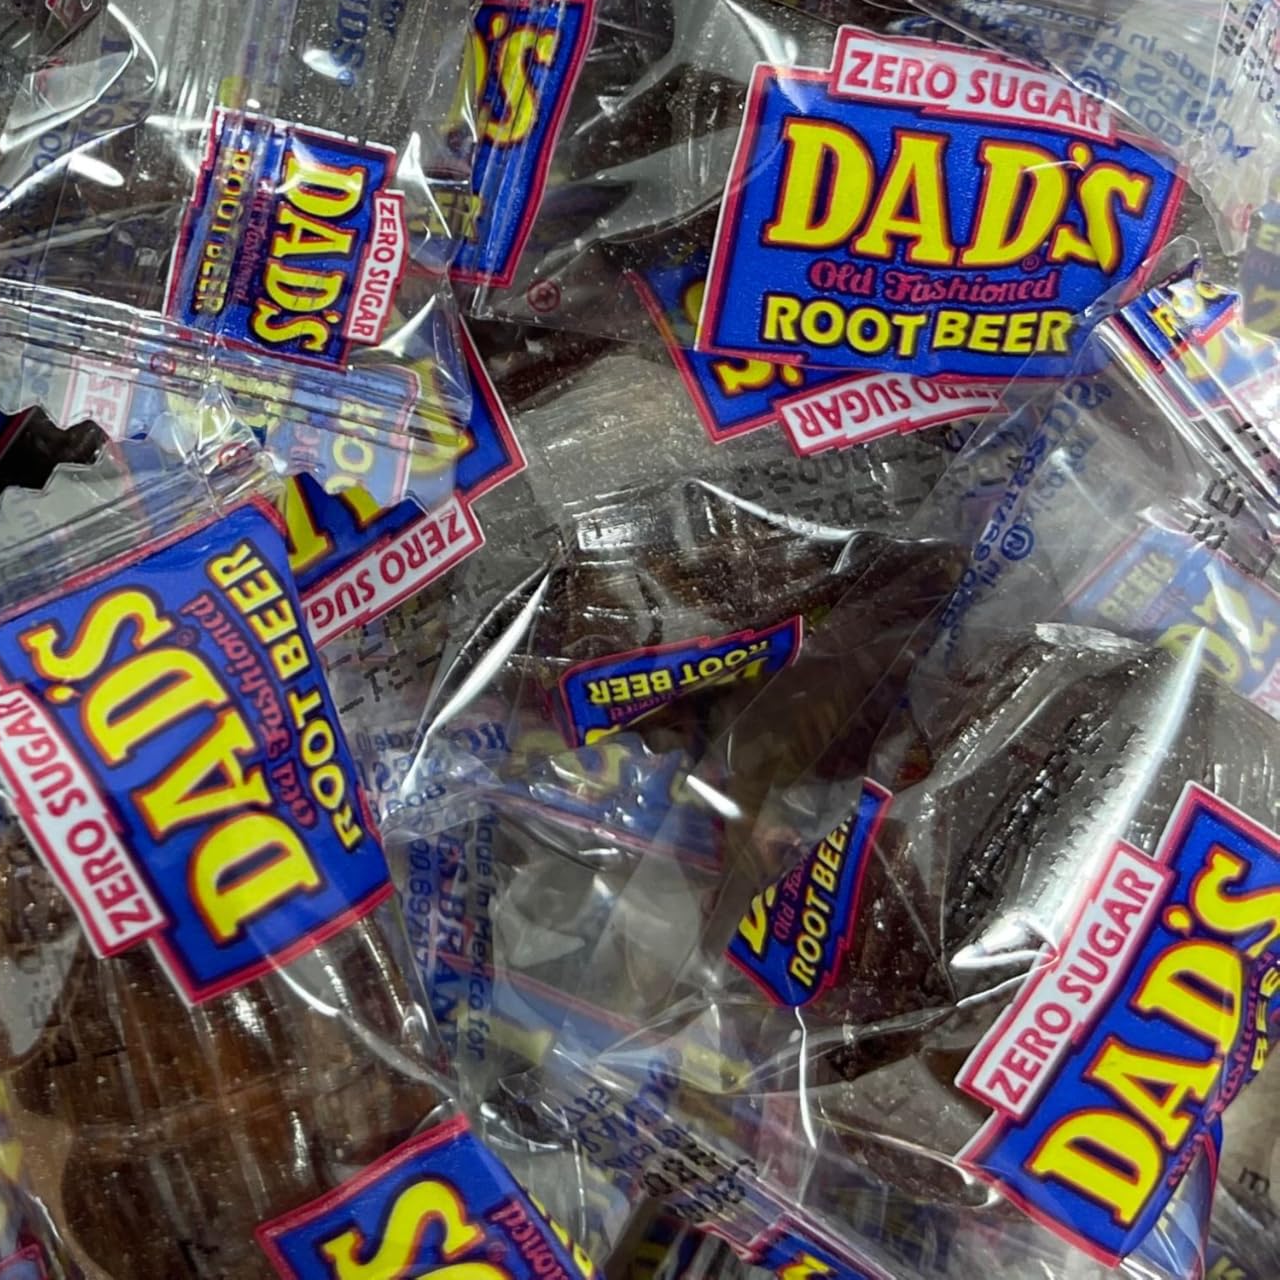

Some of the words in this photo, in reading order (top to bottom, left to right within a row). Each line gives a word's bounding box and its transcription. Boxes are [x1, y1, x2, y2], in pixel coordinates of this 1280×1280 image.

[845, 48, 959, 101] ZERO
[968, 65, 1101, 131] SUGAR
[371, 197, 404, 265] ZERO
[763, 115, 1150, 273] DAD'S
[252, 152, 366, 352] DAD'S
[350, 262, 392, 340] SUGAR
[809, 260, 875, 295] Old
[884, 263, 1059, 308] Fashioned
[764, 296, 928, 355] ROOT
[933, 310, 1073, 354] BEER
[800, 380, 914, 438] SUGAR
[378, 510, 465, 588] ZERO
[208, 542, 312, 682] BEER
[185, 595, 295, 760] Fashioned
[588, 674, 673, 706] BEER
[27, 590, 320, 944] DAD'S
[271, 760, 318, 828] Old
[288, 677, 362, 850] ROOT
[67, 823, 150, 933] ZERO
[790, 888, 834, 986] ROOT
[985, 1002, 1071, 1106] ZERO
[1064, 867, 1156, 1006] SUGAR
[1028, 844, 1280, 1228] DAD'S
